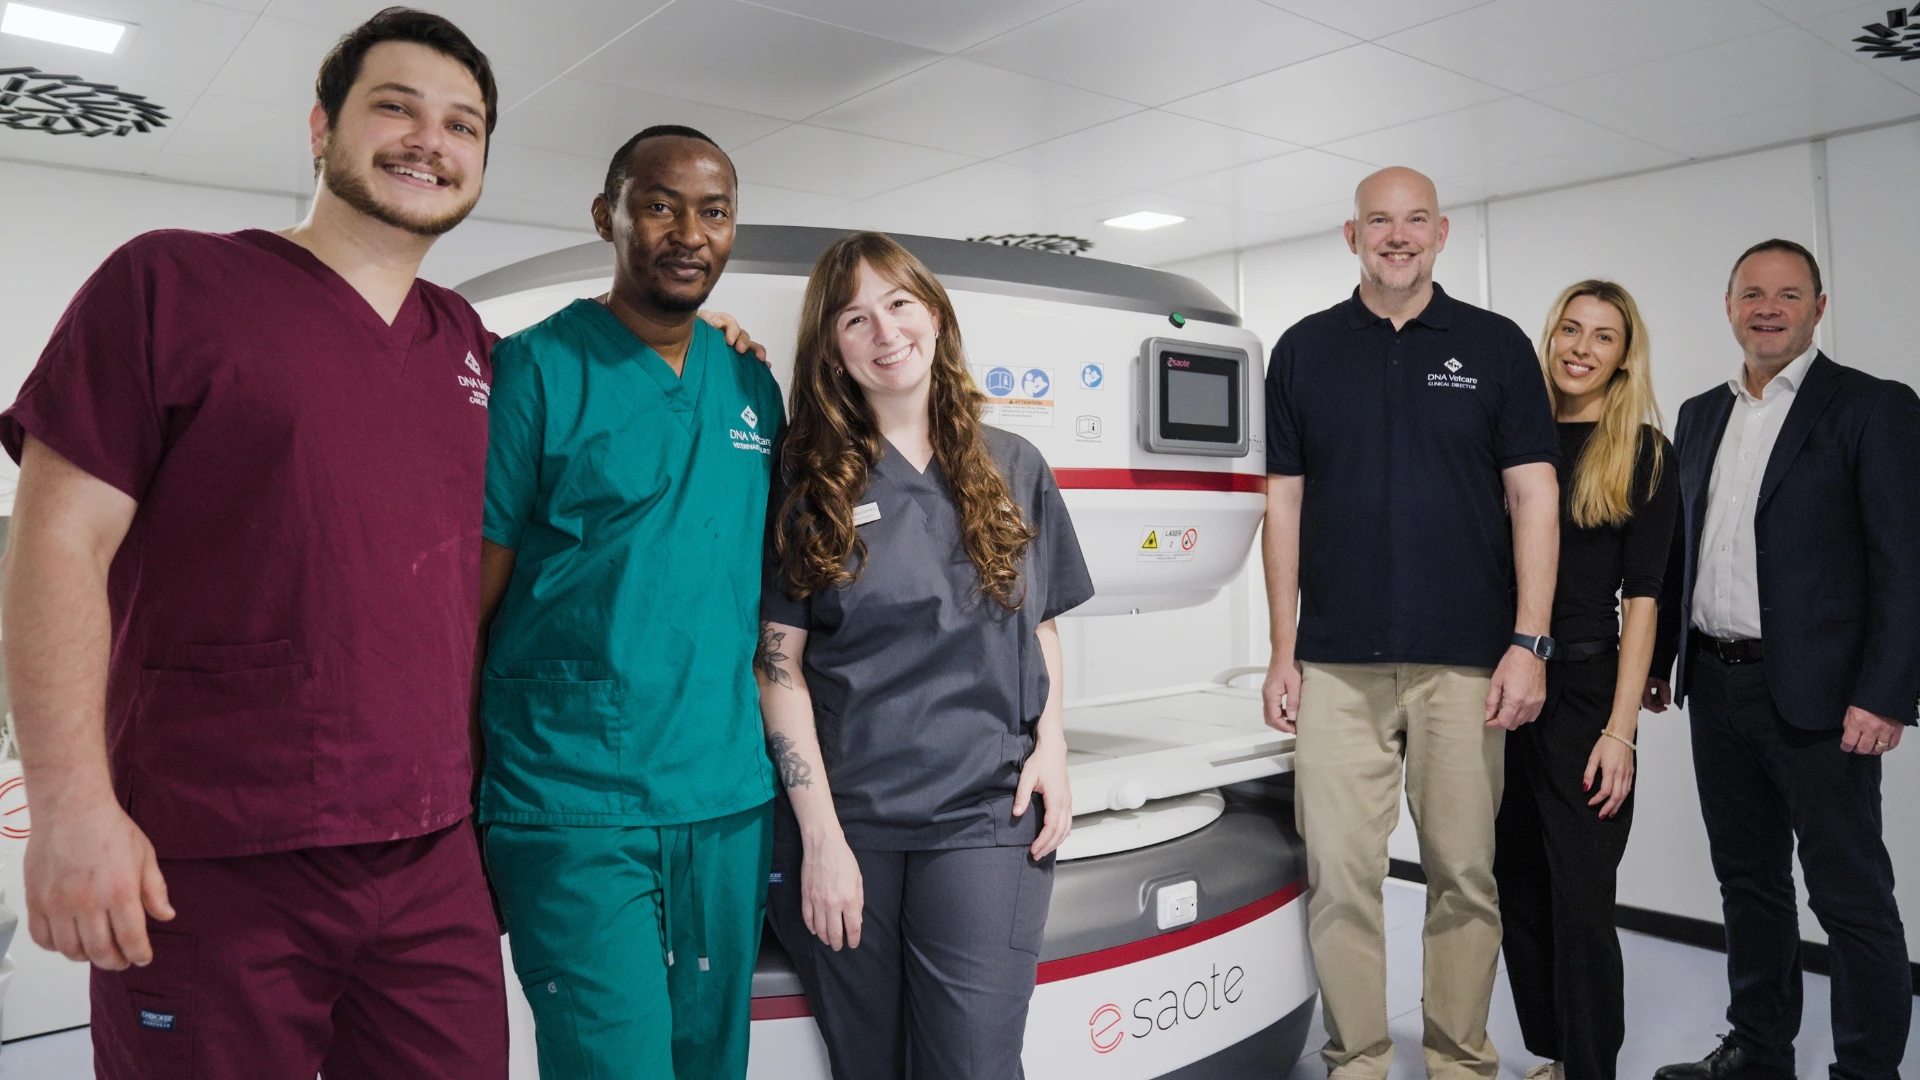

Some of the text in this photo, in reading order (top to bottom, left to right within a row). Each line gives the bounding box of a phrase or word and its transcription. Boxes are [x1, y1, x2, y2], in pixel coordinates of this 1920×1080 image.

[1167, 357, 1190, 368] esaote
[457, 375, 479, 388] DNA
[1427, 373, 1478, 384] DNA Vetcare
[1451, 382, 1476, 390] DIRECTOR
[730, 428, 749, 441] DNA
[1165, 529, 1182, 537] LASER
[1089, 963, 1245, 1054] esaote
